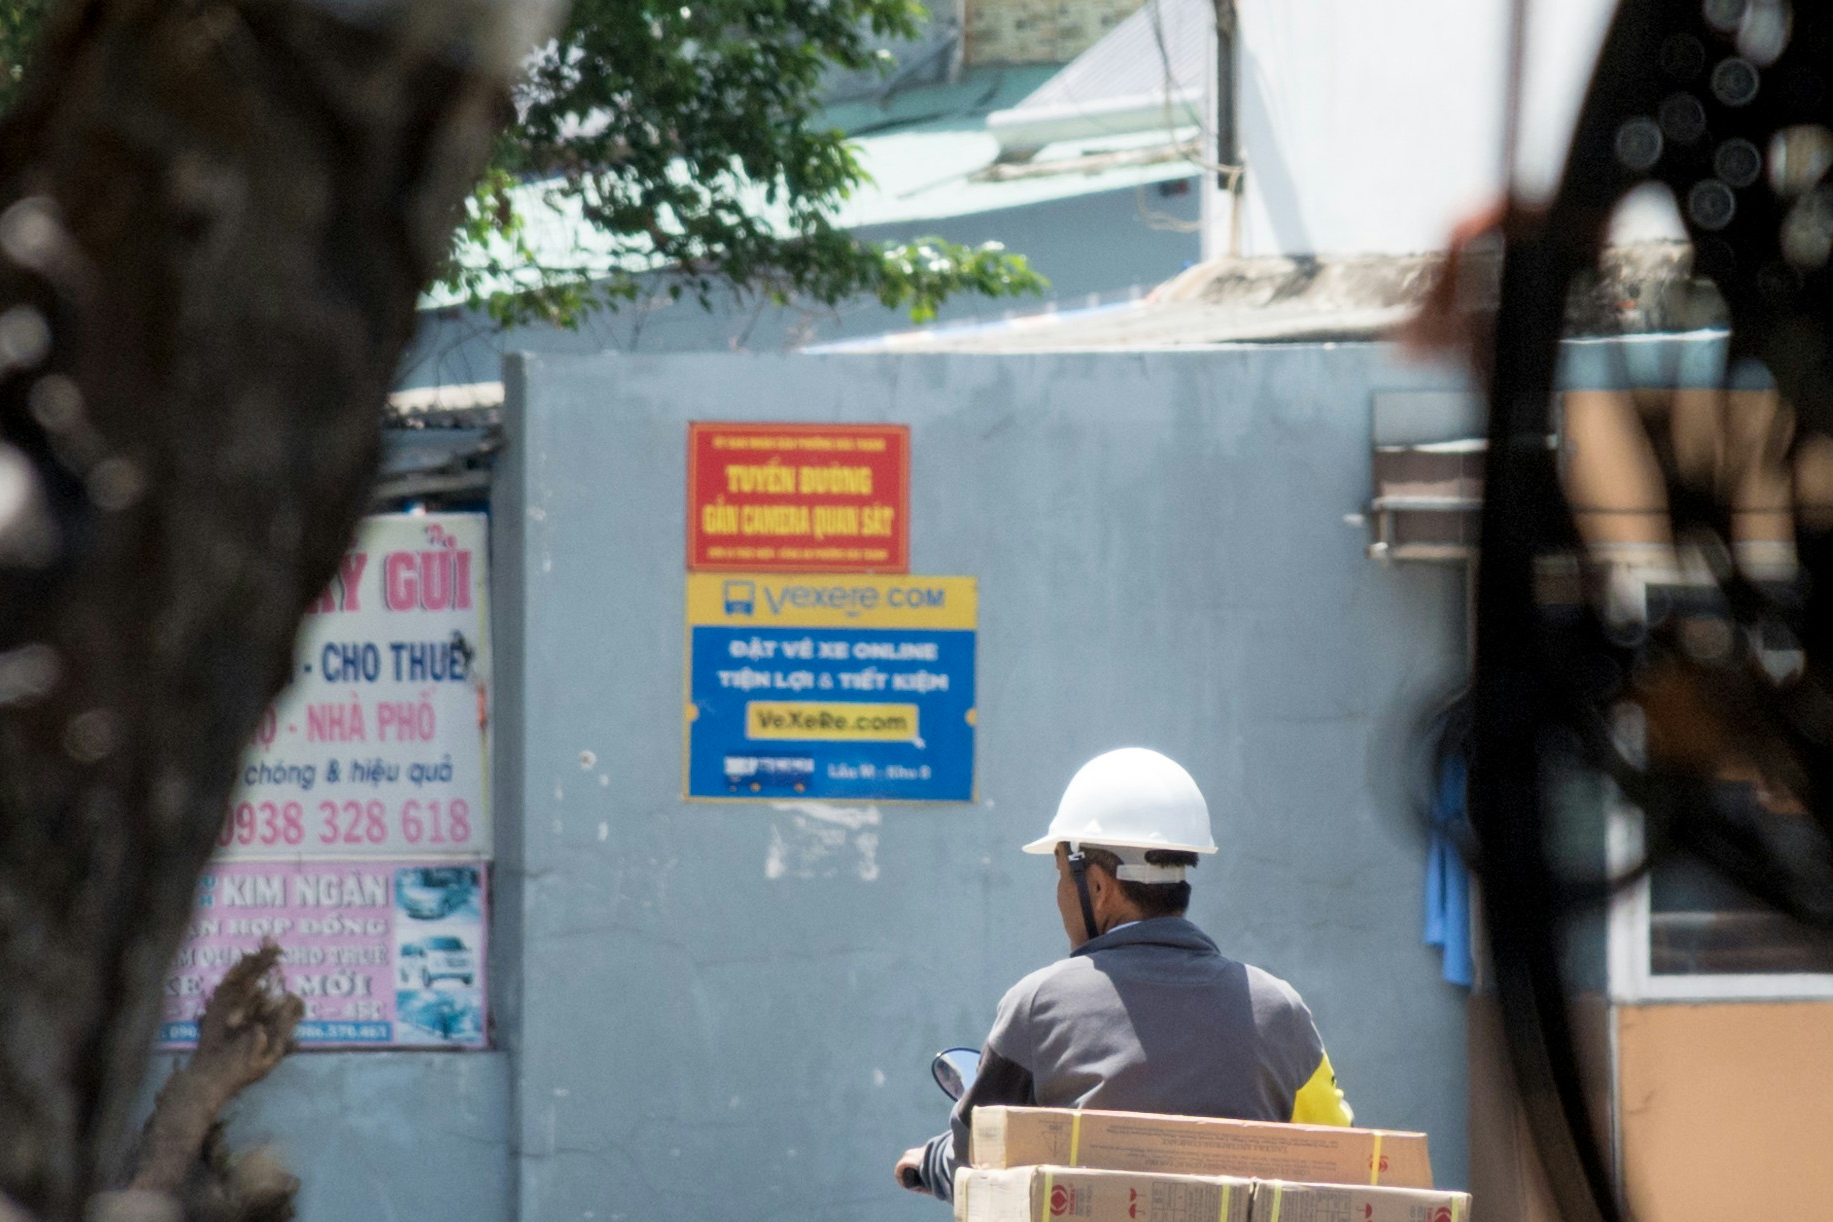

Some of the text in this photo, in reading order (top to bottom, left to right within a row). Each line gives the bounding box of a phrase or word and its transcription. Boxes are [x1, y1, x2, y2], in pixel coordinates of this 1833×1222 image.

[741, 504, 810, 536] CAMERA
[322, 641, 381, 682] CHO
[818, 641, 849, 660] XE
[853, 642, 939, 661] ONLINE
[306, 690, 365, 742] NHÀ
[244, 752, 454, 790] chóng & hiệu quả
[319, 799, 389, 845] 328
[402, 798, 471, 844] 618
[222, 874, 287, 907] KIM
